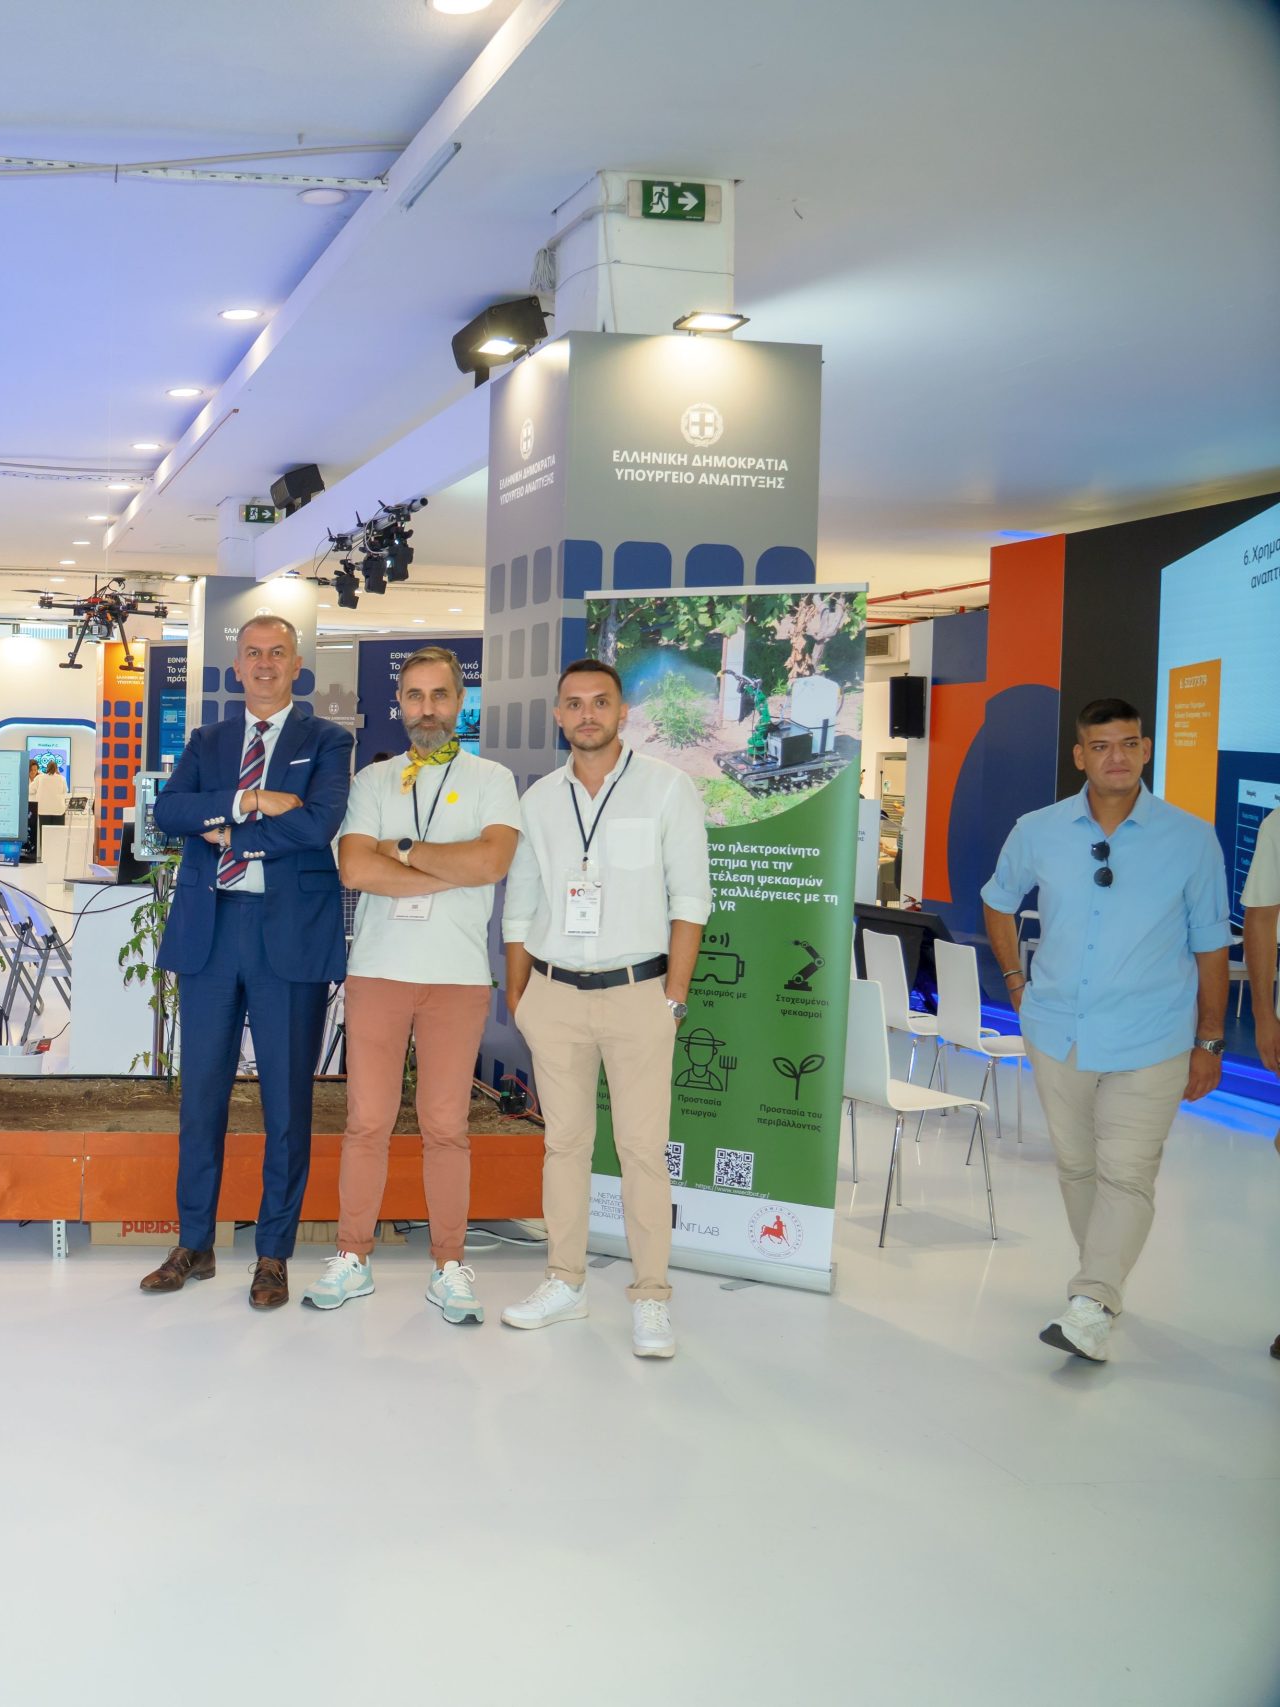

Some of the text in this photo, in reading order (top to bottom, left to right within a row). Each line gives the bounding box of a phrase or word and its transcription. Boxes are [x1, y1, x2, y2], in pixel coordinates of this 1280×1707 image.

[523, 454, 556, 479] ΔΗΜΟΚΡΑΤΙΑ
[612, 450, 789, 471] ΕΛΛΗΝΙΚΗ ΔΗΜΟΚΡΑΤΙΑ
[614, 468, 785, 489] ΥΠΟΥΡΓΕΙΟ ΑΝΑΠΤΥΞΗΣ
[167, 665, 176, 674] Το
[390, 662, 401, 670] Το
[728, 842, 820, 858] ηλεκτροκίνητο
[750, 860, 769, 871] για
[772, 860, 793, 872] την
[757, 875, 823, 888] ψεκασμών
[720, 886, 801, 903] καλλιέργειες
[804, 893, 820, 904] με
[823, 893, 839, 906] τη
[719, 901, 736, 911] VR
[736, 991, 748, 1000] με
[776, 994, 829, 1007] Στοχευμένοι
[703, 1000, 714, 1008] VR
[780, 1008, 822, 1019] ψεκασμοί
[678, 1094, 722, 1107] Προστασία
[681, 1107, 717, 1118] γεωργού
[760, 1103, 822, 1119] Προστασία του
[757, 1117, 821, 1132] περιβάλλοντος
[698, 1224, 720, 1236] LAB
